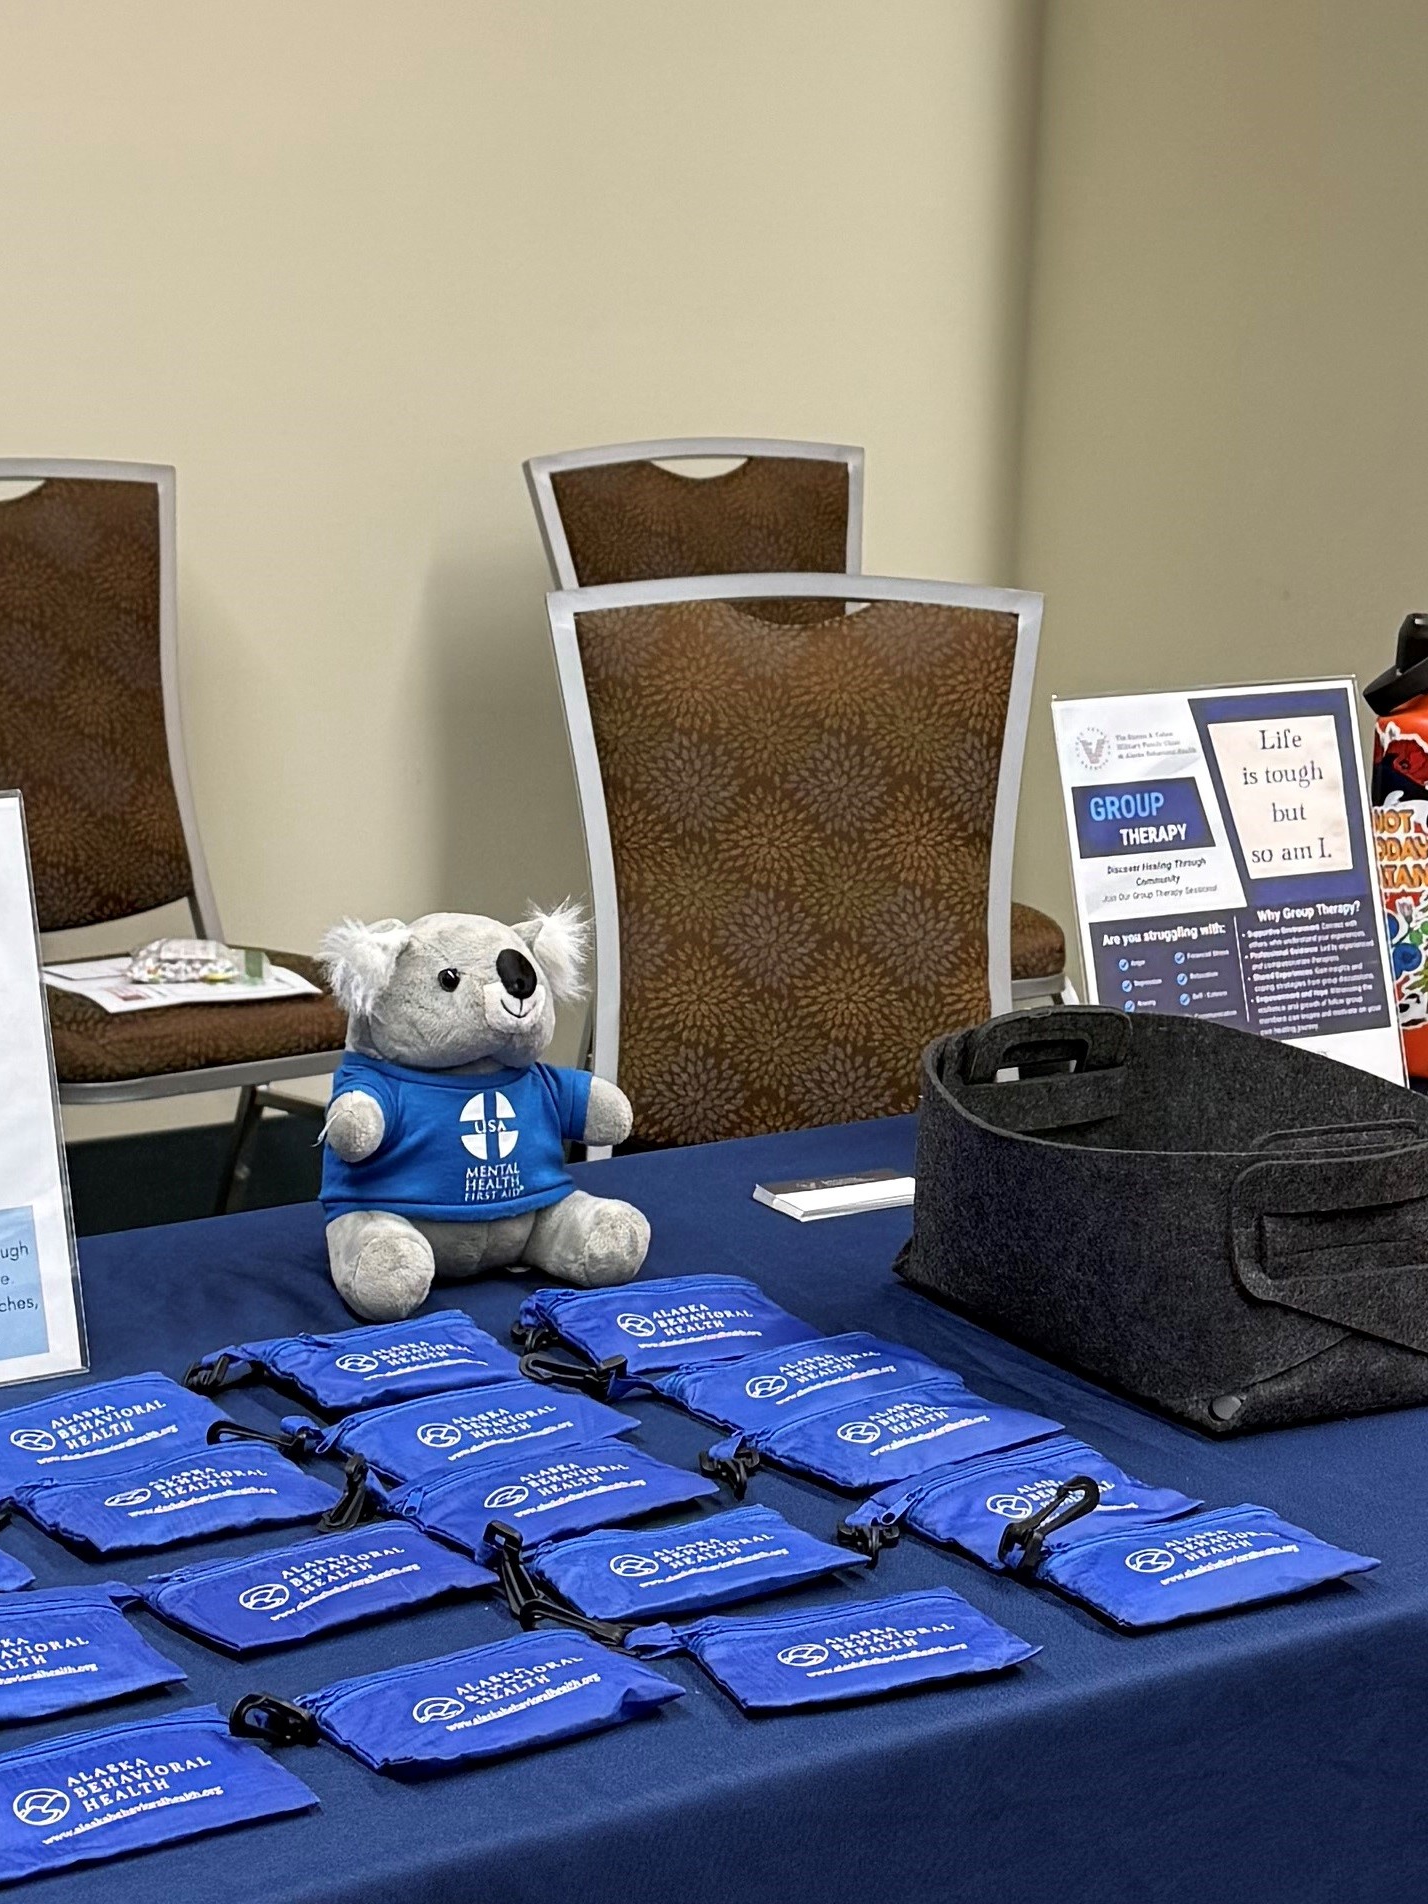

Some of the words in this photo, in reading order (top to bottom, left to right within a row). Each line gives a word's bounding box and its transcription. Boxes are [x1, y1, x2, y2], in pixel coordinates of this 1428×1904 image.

[1259, 729, 1302, 750] Life
[1243, 766, 1258, 785] is
[1265, 761, 1323, 788] tough
[1090, 792, 1164, 821] GROUP
[1272, 802, 1307, 823] but
[1374, 809, 1414, 833] NOT
[1120, 824, 1187, 846] THERAPY
[1252, 847, 1272, 864] so
[1282, 846, 1312, 861] am
[1318, 837, 1332, 859] I.
[1377, 837, 1428, 861] ODAY
[1257, 909, 1280, 923] Why
[1283, 905, 1314, 920] Group
[1316, 900, 1360, 918] Therapy?
[1102, 932, 1121, 946] Are
[1122, 932, 1142, 947] you
[1143, 926, 1198, 942] struggling
[474, 1119, 506, 1134] USA
[466, 1162, 520, 1178] MENTAL
[465, 1176, 520, 1192] HEALTH
[65, 1420, 135, 1450] HEALTH
[66, 1757, 149, 1787] ALASKA
[73, 1755, 212, 1799] BEHAVIORAL
[82, 1778, 170, 1813] HEALTH
